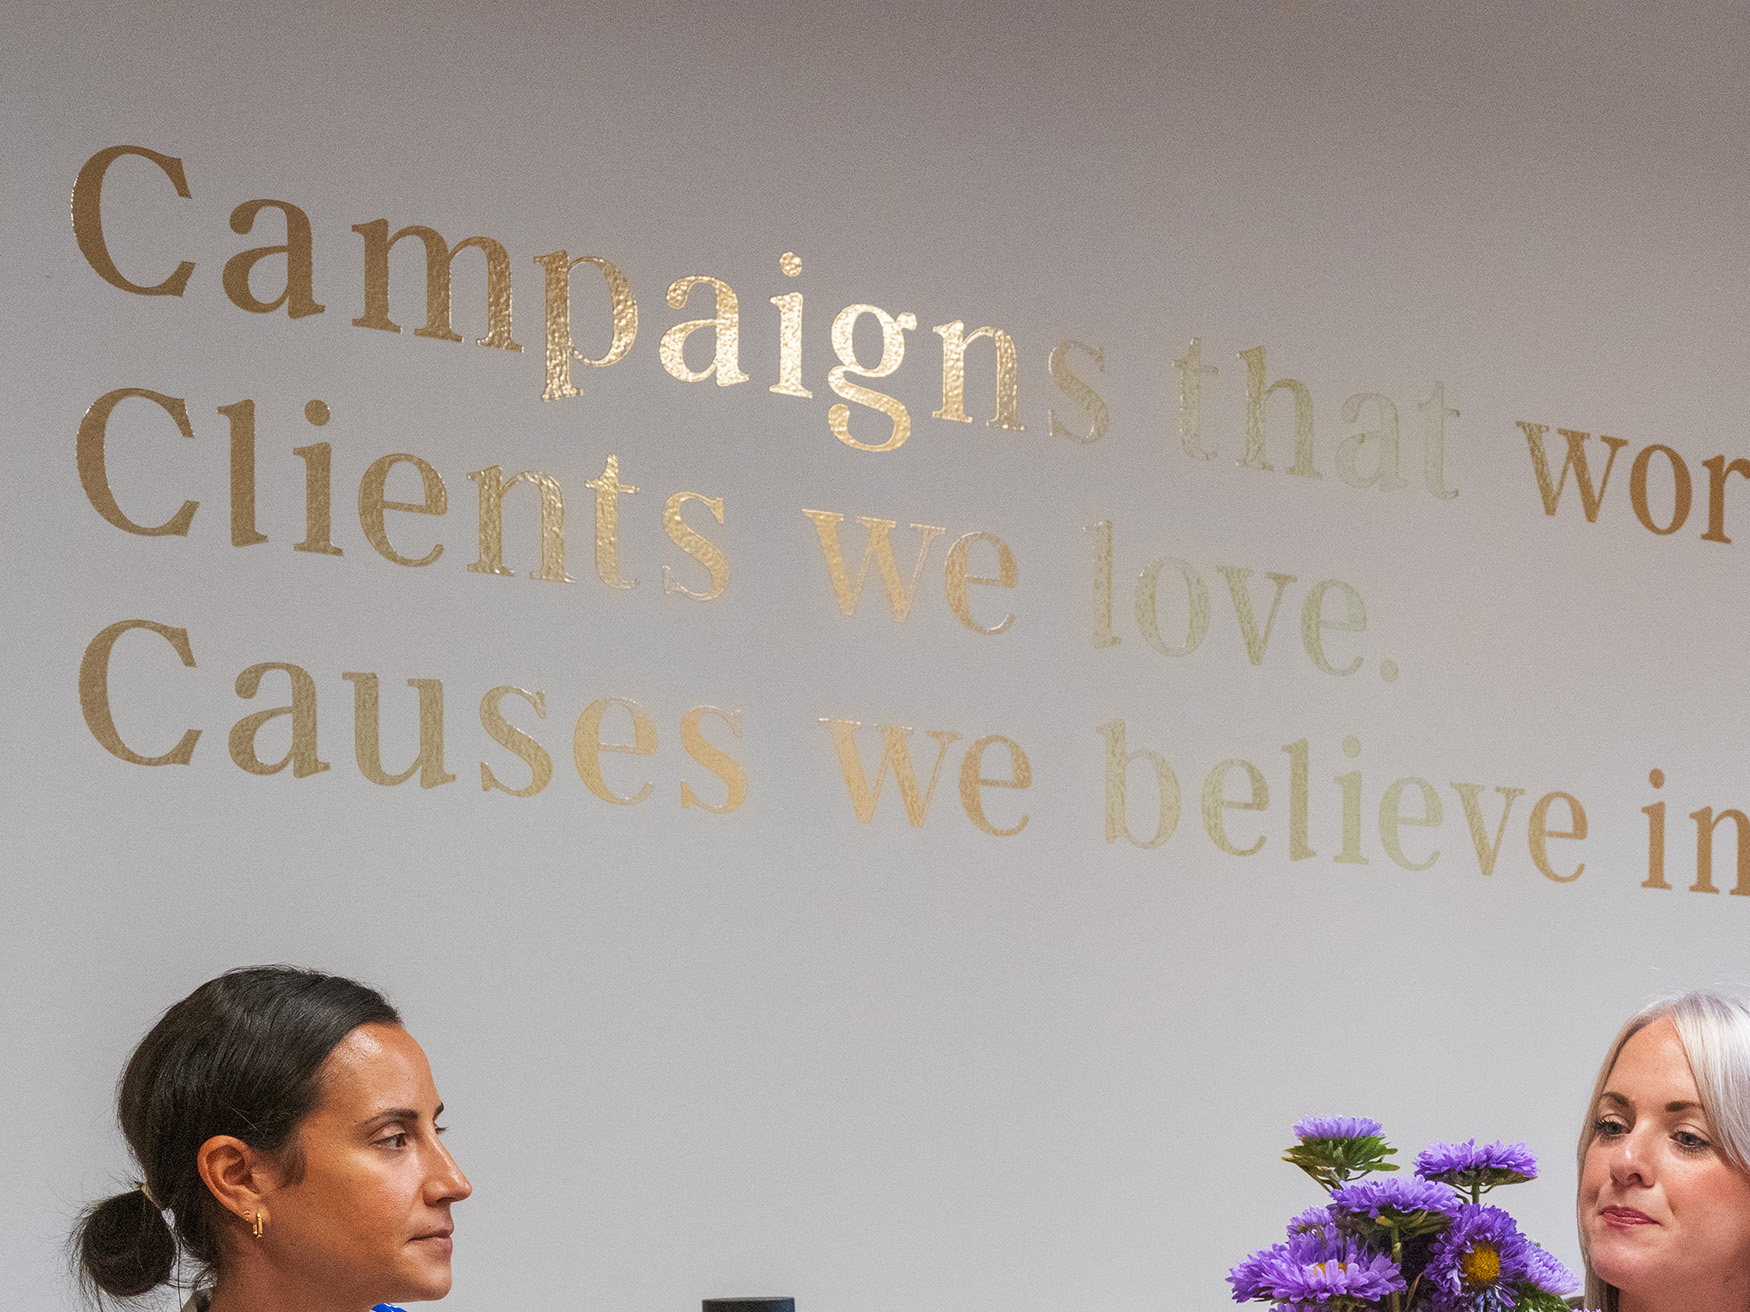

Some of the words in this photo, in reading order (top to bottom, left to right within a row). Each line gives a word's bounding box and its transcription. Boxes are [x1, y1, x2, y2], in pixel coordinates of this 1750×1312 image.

[71, 144, 1108, 453] Campaigns
[1173, 337, 1460, 501] that
[75, 388, 731, 602] Clients
[802, 508, 1018, 636] we
[1082, 519, 1400, 683] love.
[78, 619, 749, 814] Causes
[818, 717, 1032, 837] we
[1095, 719, 1590, 883] believe
